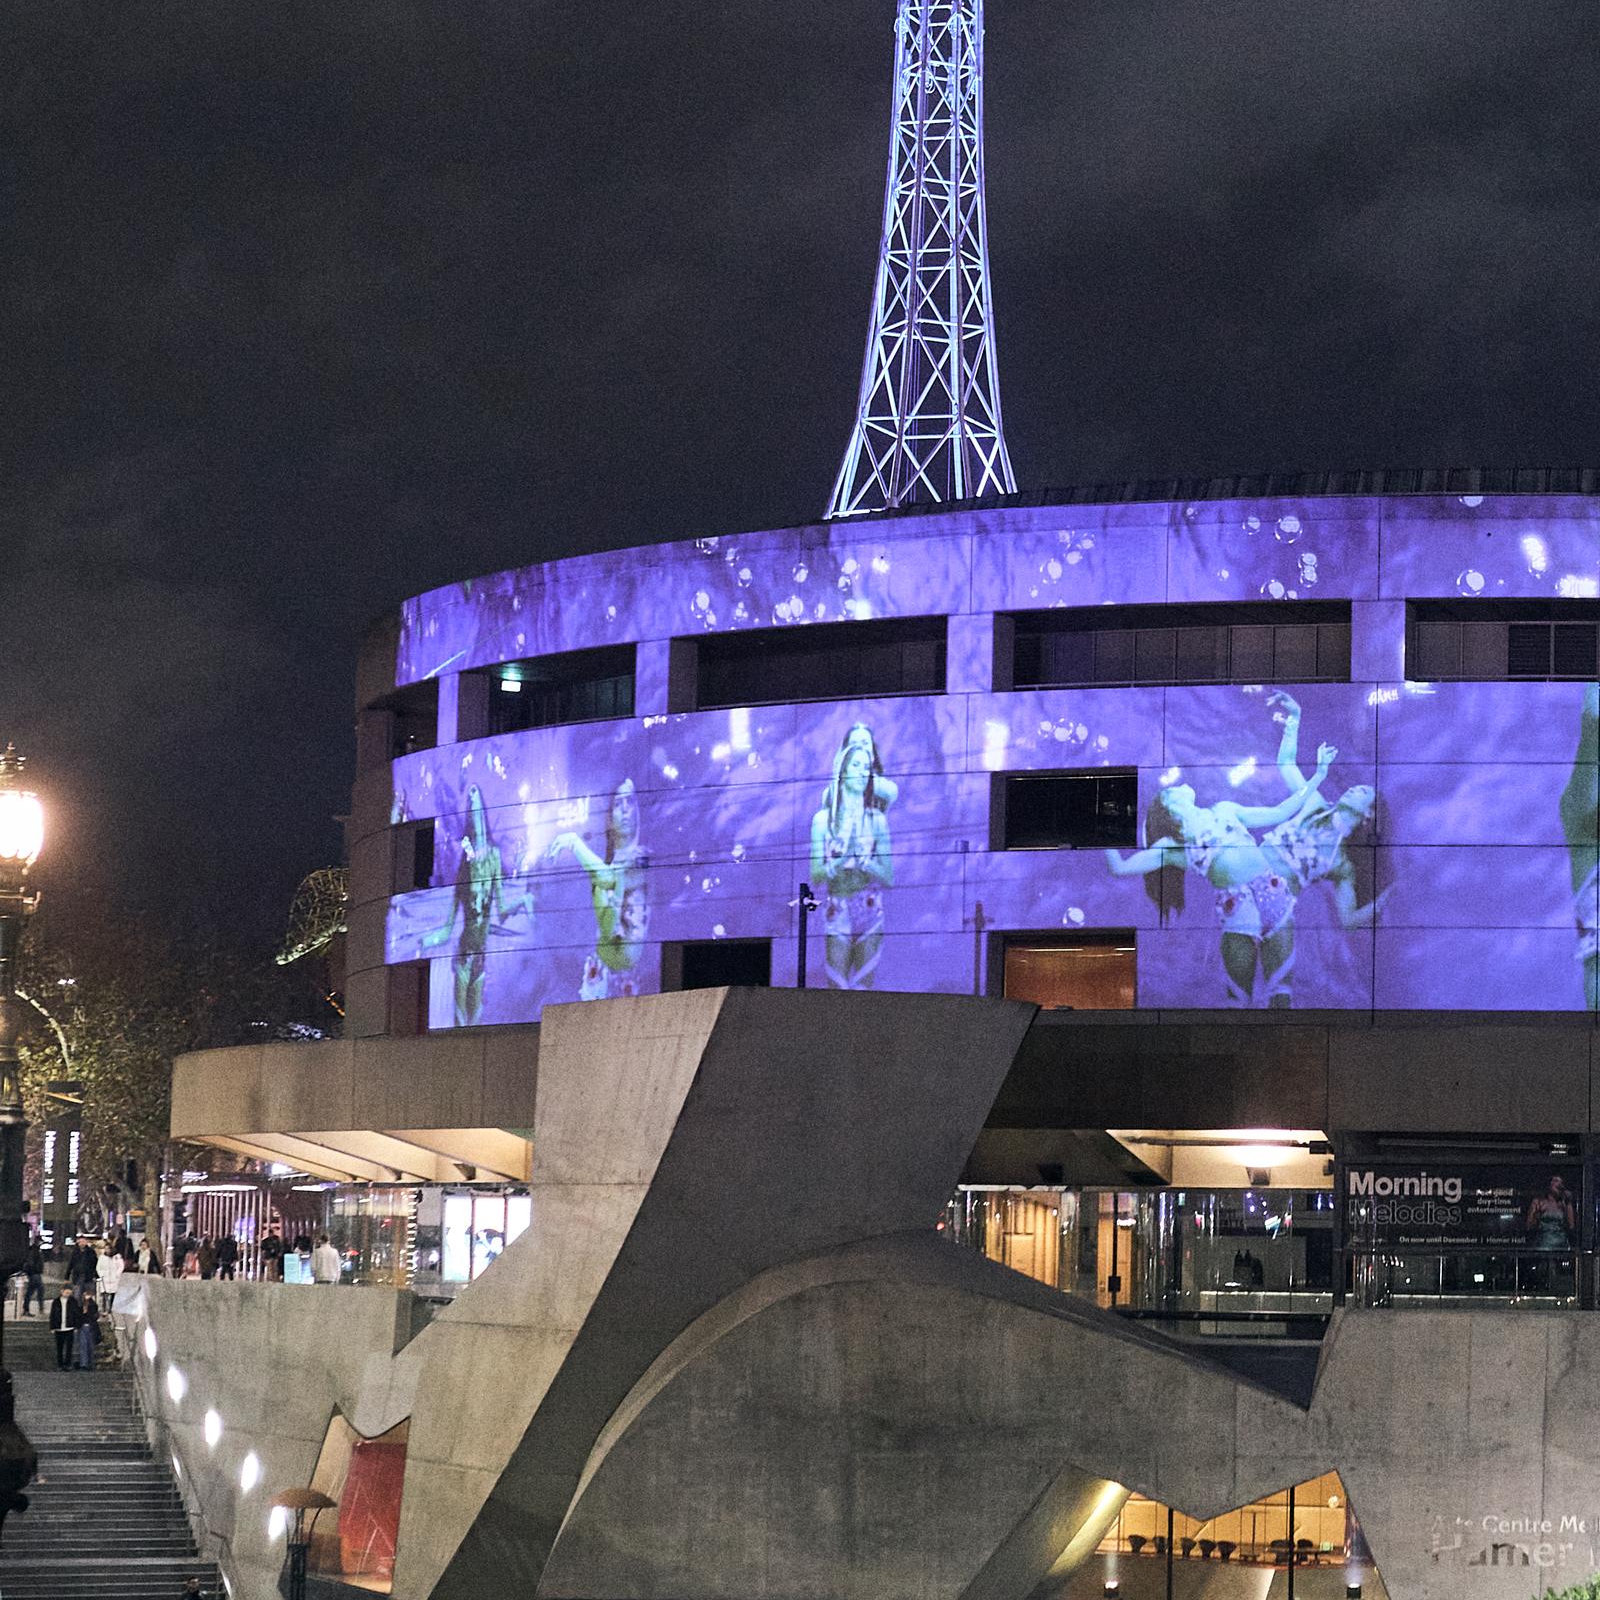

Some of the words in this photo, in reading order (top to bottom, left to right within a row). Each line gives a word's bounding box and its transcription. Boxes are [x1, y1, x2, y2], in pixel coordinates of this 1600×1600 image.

[45, 1130, 57, 1174] Hamer
[69, 1131, 81, 1174] Hamer
[43, 1178, 55, 1204] Hall
[68, 1178, 80, 1204] Hall
[1349, 1171, 1462, 1204] Morning
[1349, 1200, 1462, 1225] Melodies
[1432, 1515, 1474, 1532] Ats
[1482, 1515, 1553, 1533] Centre
